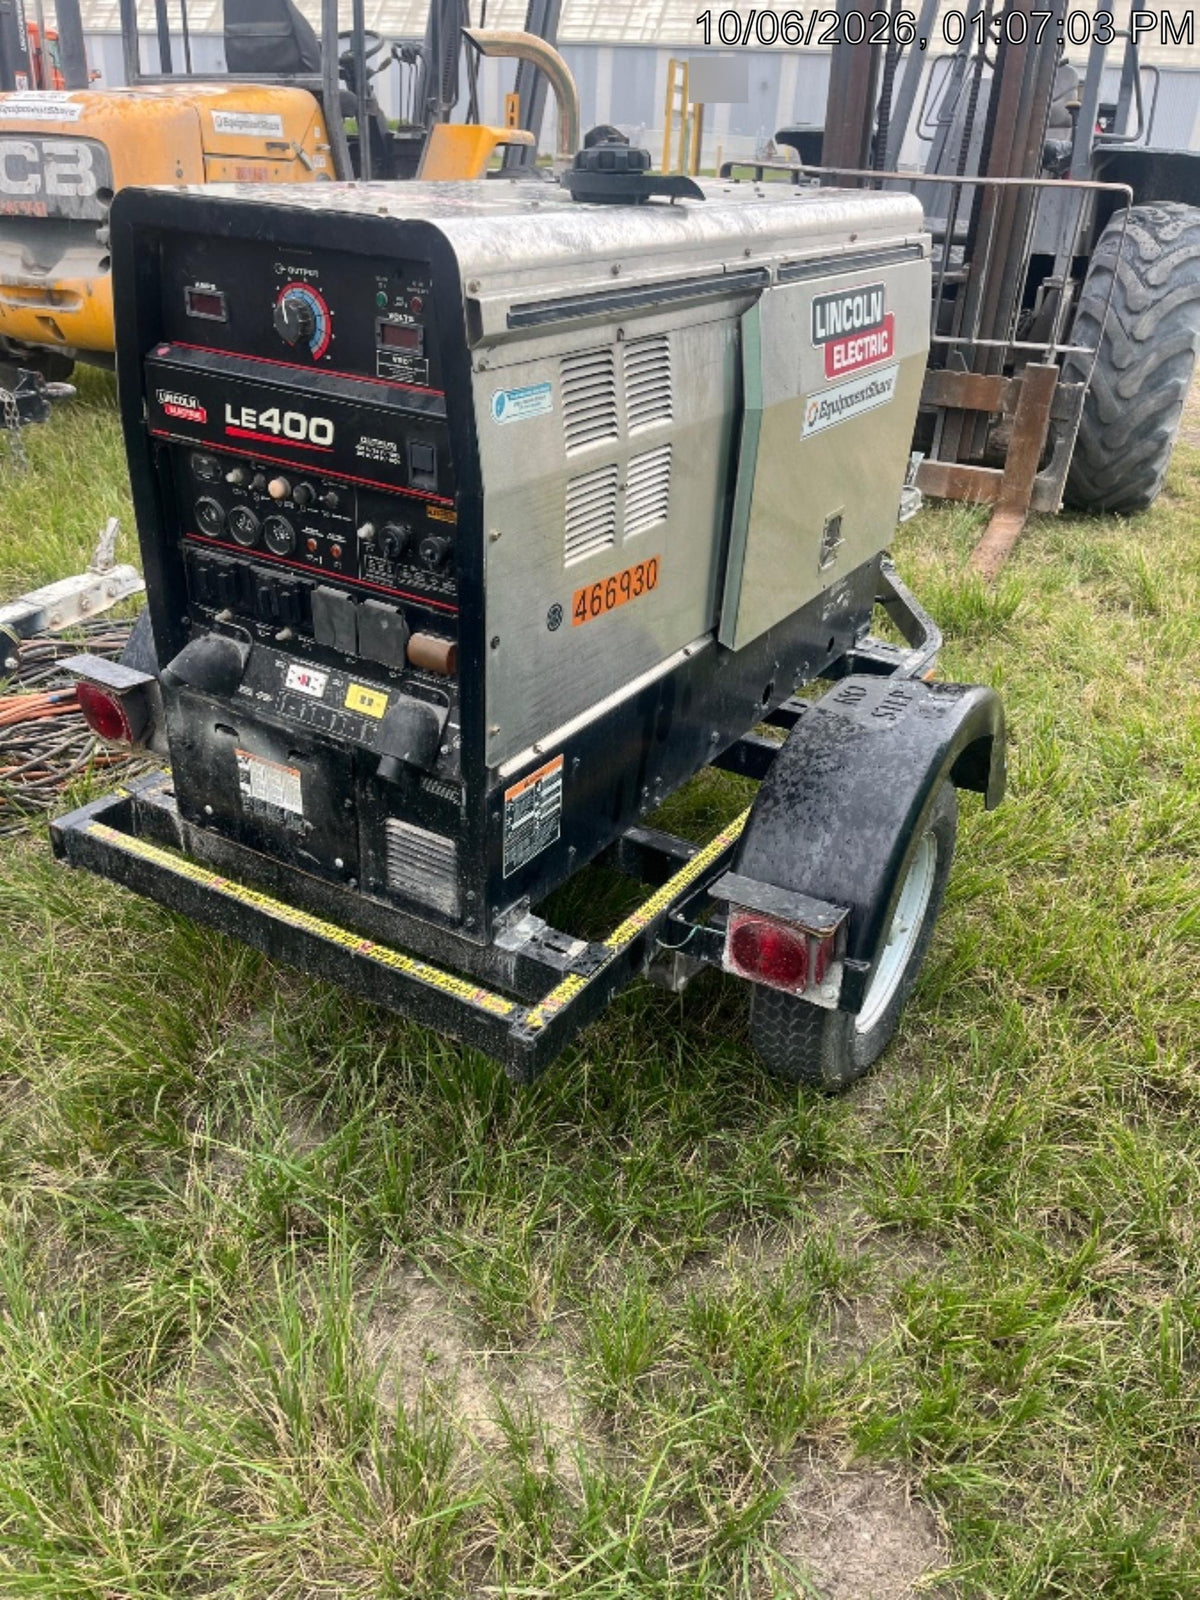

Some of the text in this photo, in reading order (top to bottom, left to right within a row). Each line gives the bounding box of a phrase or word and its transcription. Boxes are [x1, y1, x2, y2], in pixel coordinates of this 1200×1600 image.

[814, 290, 884, 339] LINCOLN
[832, 330, 889, 371] ELECTRIC
[225, 403, 335, 447] LE400
[574, 557, 659, 622] 466930
